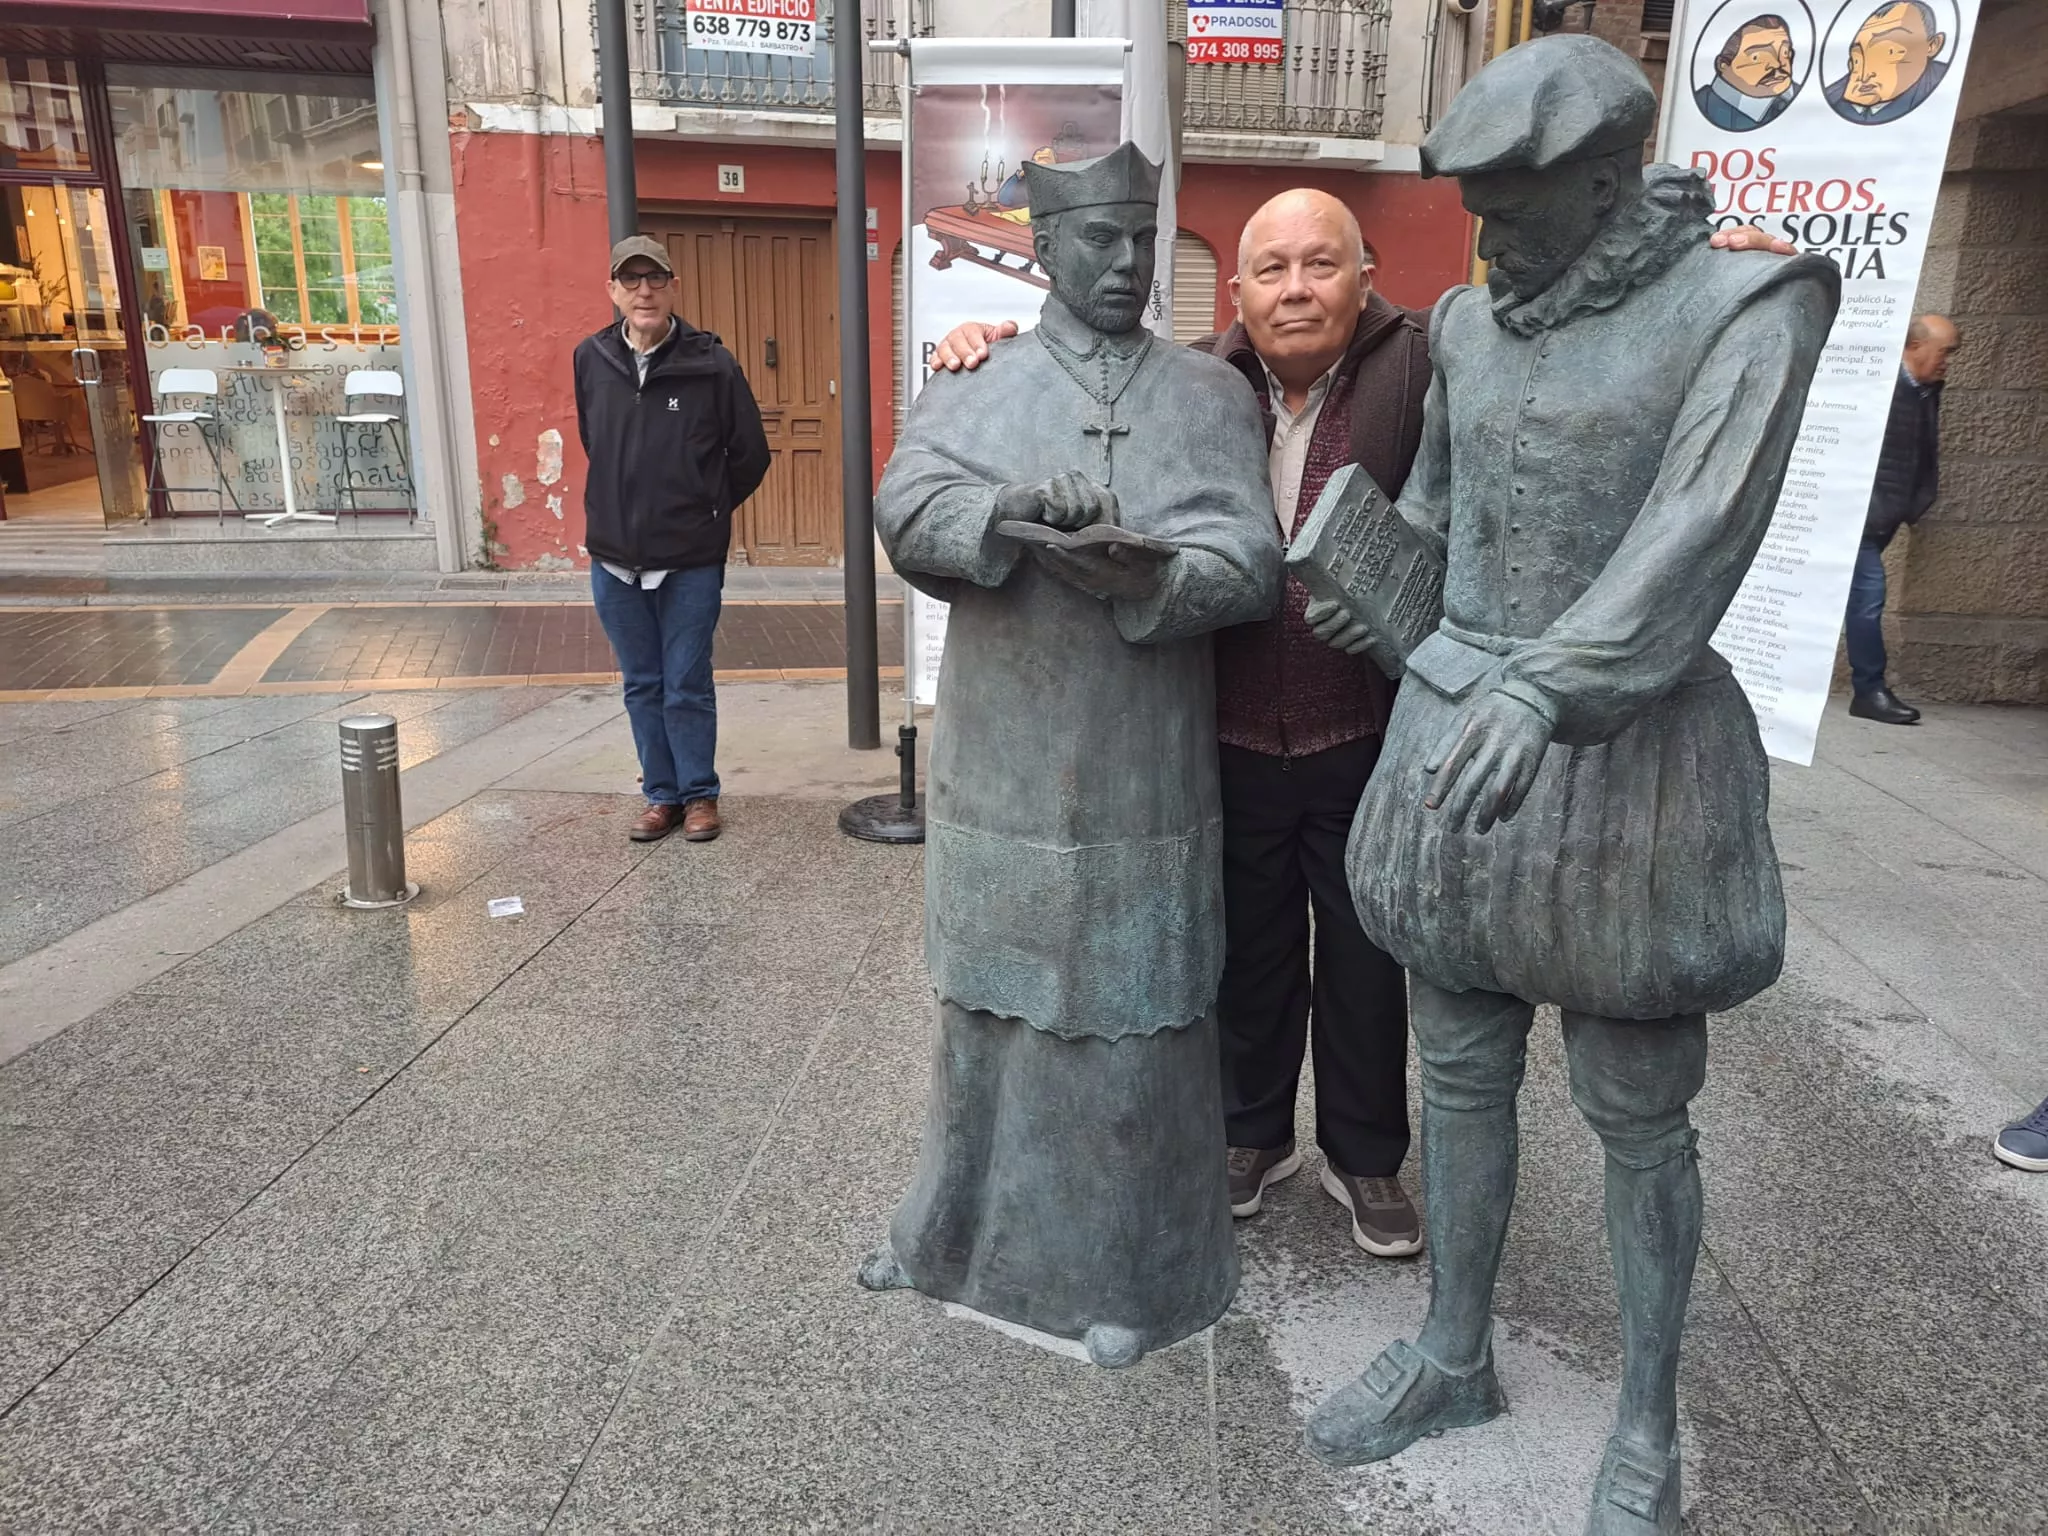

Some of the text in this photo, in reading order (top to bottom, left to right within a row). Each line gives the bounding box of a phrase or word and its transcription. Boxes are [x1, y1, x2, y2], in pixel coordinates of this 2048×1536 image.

[747, 0, 810, 17] EDIFICIO
[693, 15, 811, 42] 638 779 873
[1210, 16, 1278, 28] PRADOSOL
[760, 42, 799, 51] BARBASTRO
[1188, 42, 1280, 59] 974 308 995
[1689, 147, 1777, 182] DOS
[723, 171, 739, 186] 38
[1711, 178, 1886, 214] UCEROS,
[1781, 211, 1910, 246] SOLES
[1152, 280, 1163, 321] Solero
[1849, 344, 1886, 353] ninguno
